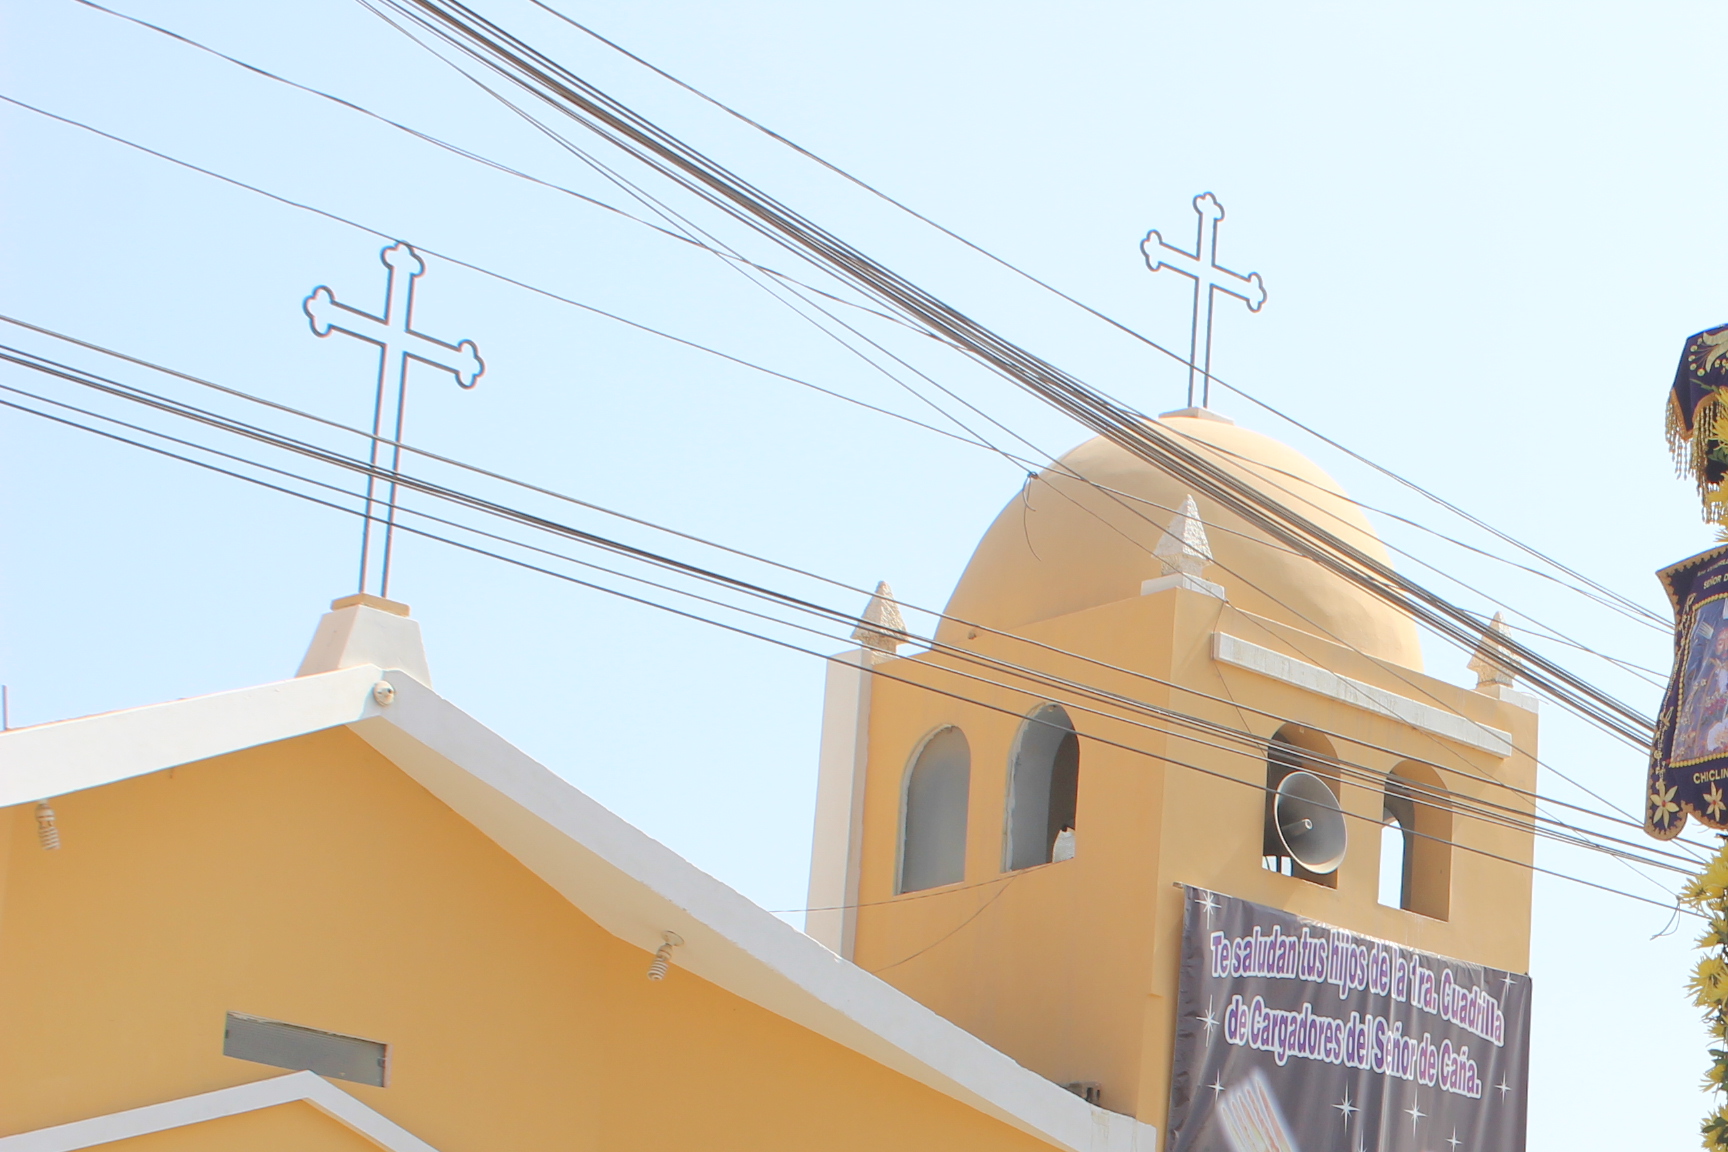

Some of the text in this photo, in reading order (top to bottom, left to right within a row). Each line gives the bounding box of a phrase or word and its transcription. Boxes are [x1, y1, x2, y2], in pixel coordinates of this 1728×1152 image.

[1703, 575, 1722, 590] SEÑOR
[1211, 925, 1505, 1047] Te saludan tus hijos de la 1ra. Cuadrilla
[1225, 995, 1482, 1099] de Cargadores del Señor de Caña.
